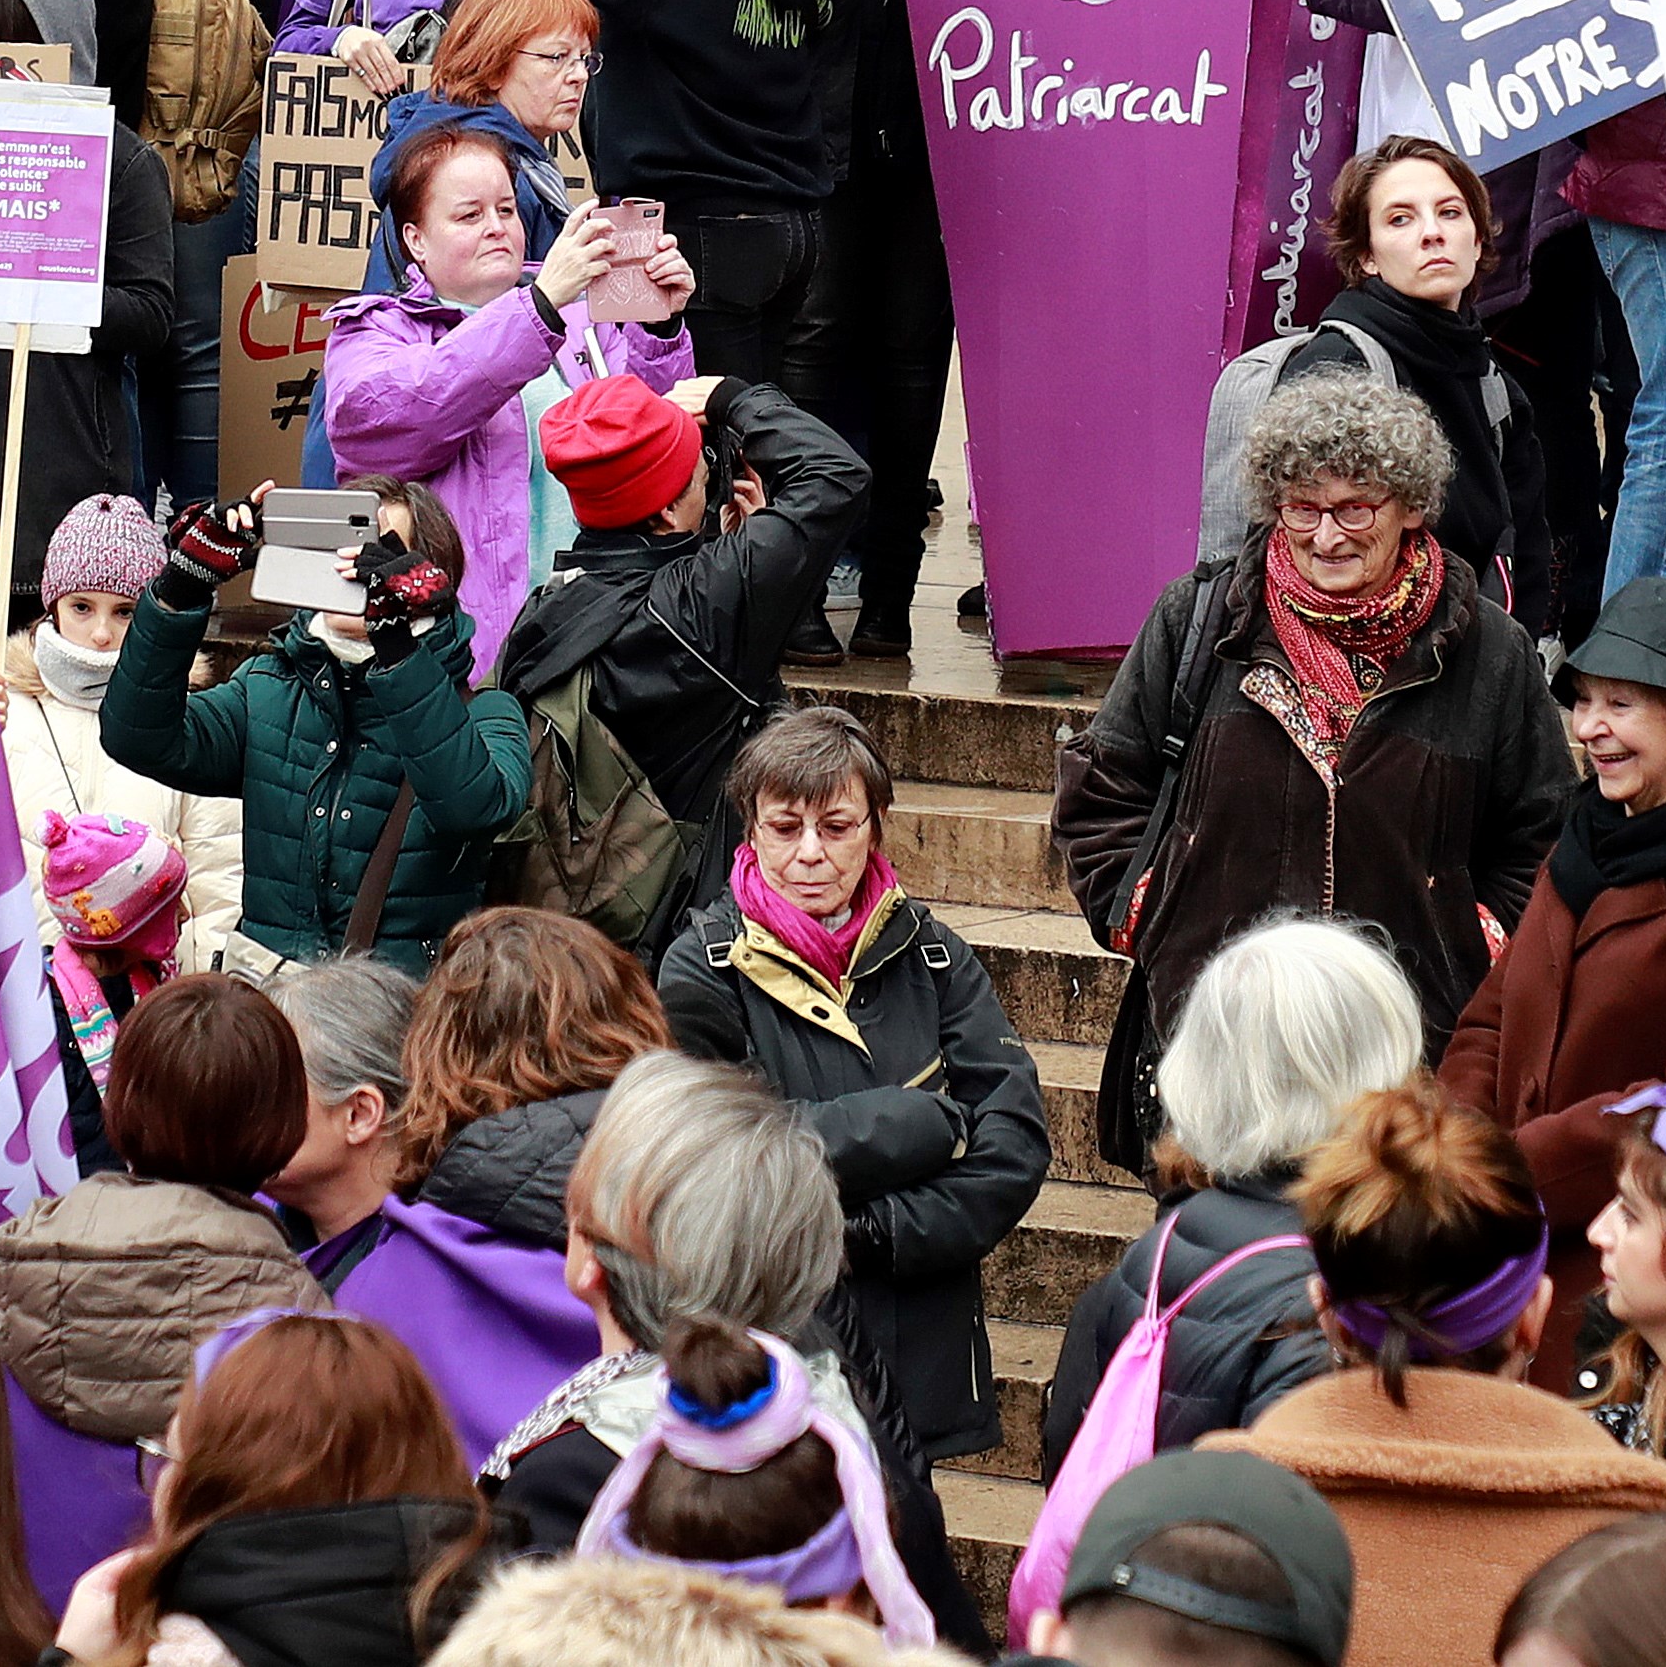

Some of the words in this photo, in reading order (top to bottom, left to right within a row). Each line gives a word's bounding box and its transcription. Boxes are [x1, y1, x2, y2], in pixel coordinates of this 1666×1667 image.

[264, 61, 349, 137] FAIS
[927, 4, 1232, 132] Patriarcat
[1445, 15, 1632, 158] NOTRE
[7, 153, 87, 170] responsable
[38, 142, 72, 156] n'est
[269, 161, 365, 250] PAS
